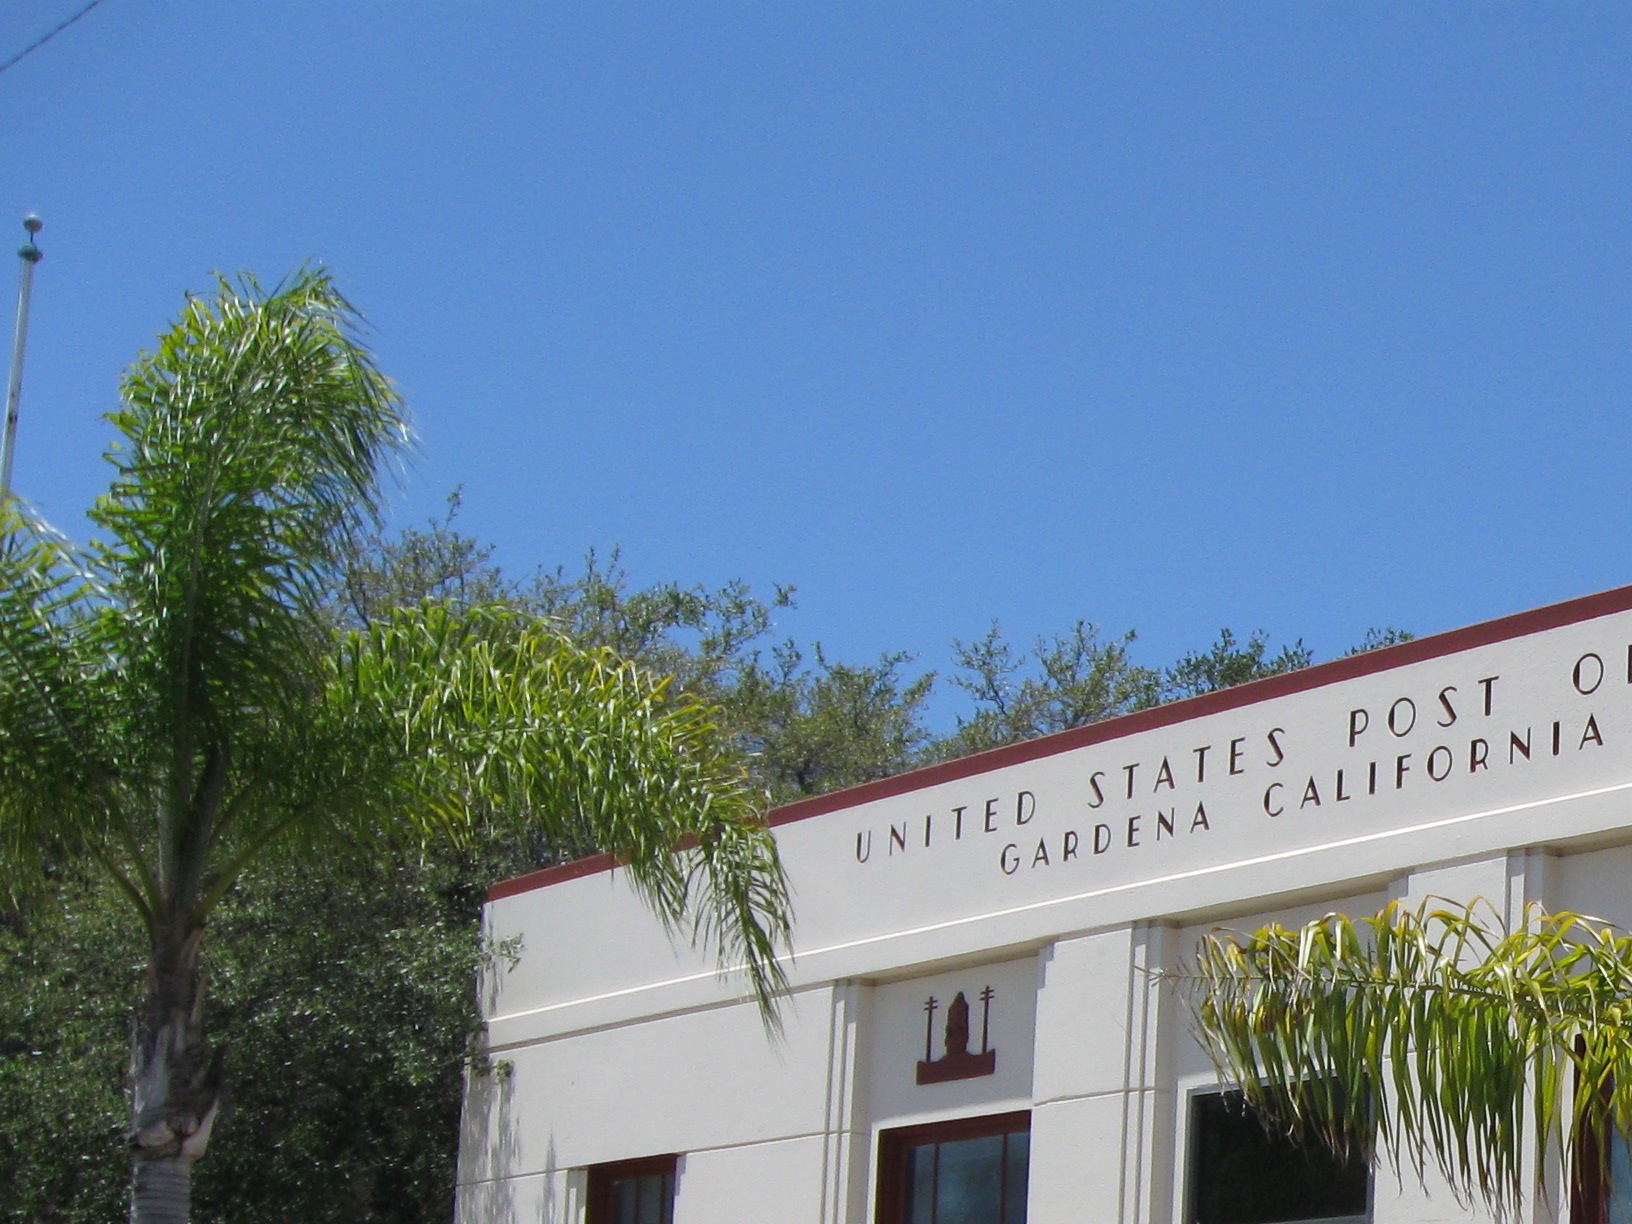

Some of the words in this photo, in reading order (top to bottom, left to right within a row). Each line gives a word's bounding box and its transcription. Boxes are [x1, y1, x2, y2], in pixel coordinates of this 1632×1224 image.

[857, 790, 1036, 861] UNITED
[1088, 727, 1285, 808] STATES
[1349, 675, 1500, 748] POST
[1000, 801, 1211, 876] GARDENA
[1263, 713, 1604, 818] CALIFORNIA
